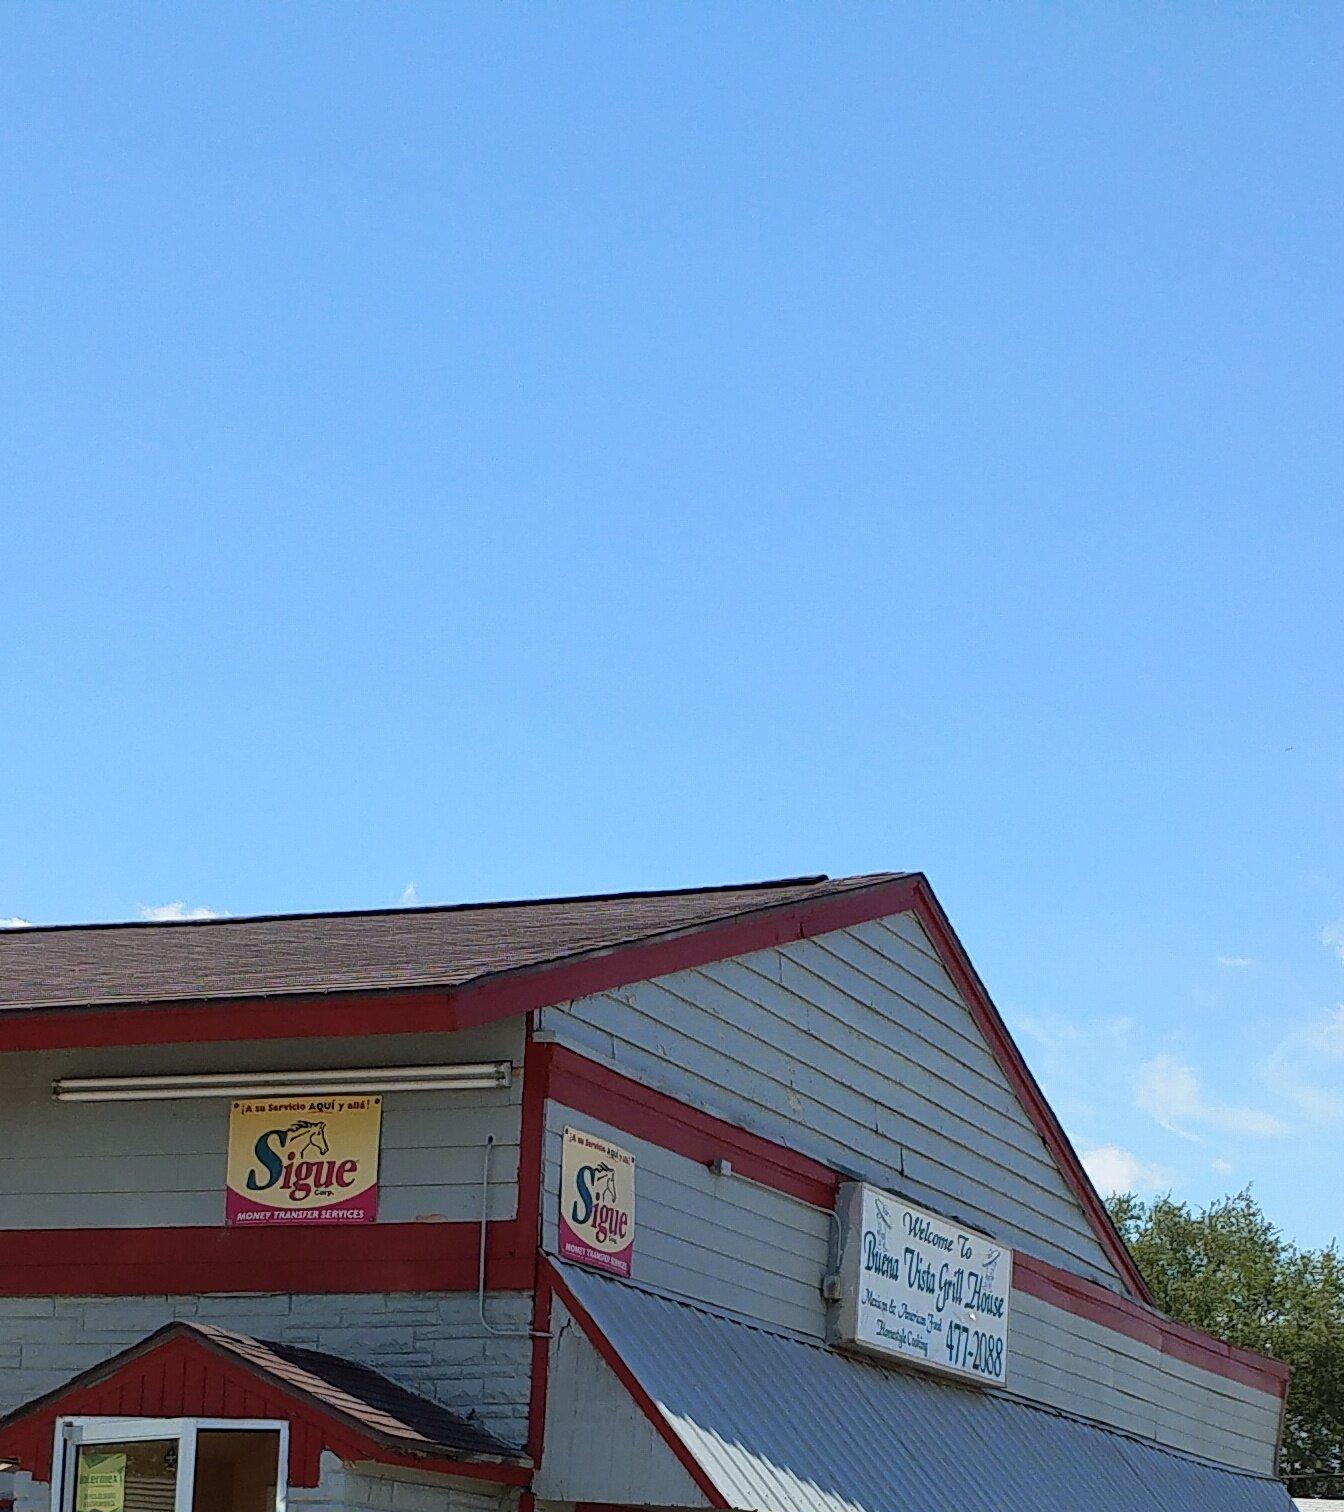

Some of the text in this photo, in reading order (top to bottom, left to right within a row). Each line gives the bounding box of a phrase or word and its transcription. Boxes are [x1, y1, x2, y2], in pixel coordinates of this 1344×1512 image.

[255, 1104, 266, 1112] su
[268, 1102, 306, 1111] Servicio
[308, 1099, 335, 1112] AQUÍ
[338, 1103, 345, 1112] y
[246, 1130, 358, 1201] Sigue
[237, 1209, 364, 1221] MONEY TRANSFER SERVICES
[314, 1189, 334, 1197] Corp.
[572, 1165, 628, 1243] Sigue
[903, 1212, 973, 1259] Welcome To
[864, 1231, 1005, 1318] Buena Vista Grill House
[926, 1313, 942, 1333] Food
[946, 1320, 1003, 1377] 477-2088
